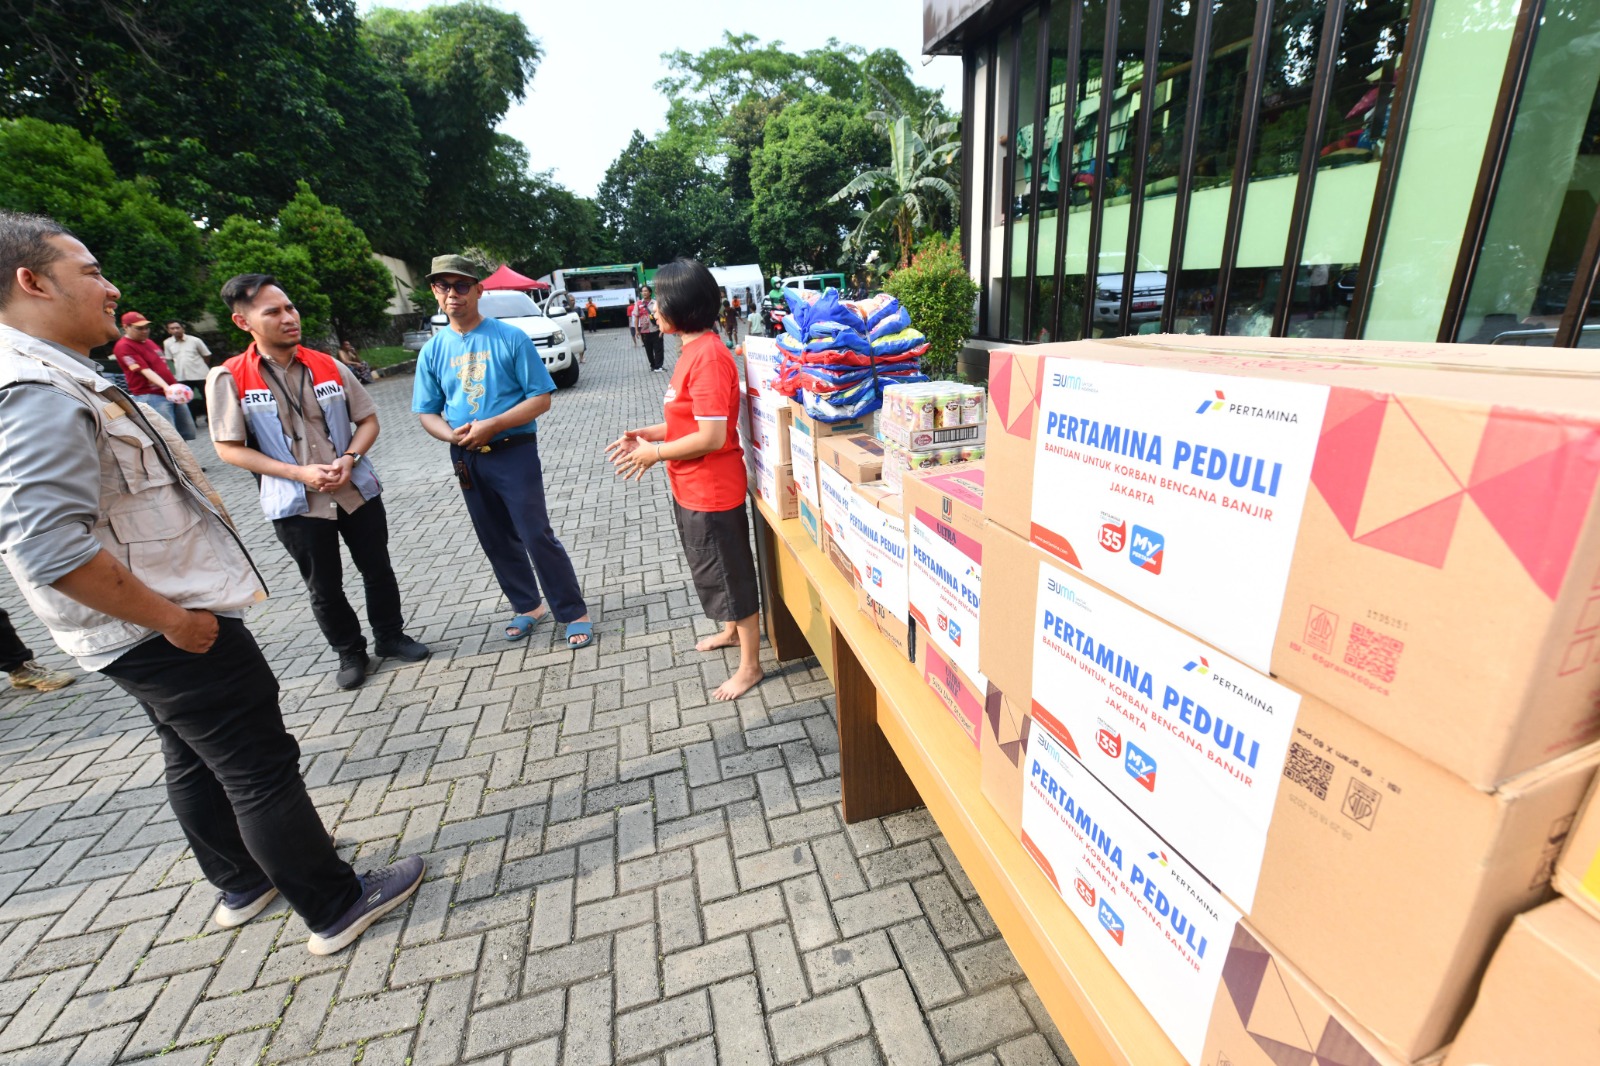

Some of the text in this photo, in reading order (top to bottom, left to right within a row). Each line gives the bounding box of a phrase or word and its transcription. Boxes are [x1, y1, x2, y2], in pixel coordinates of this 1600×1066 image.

[1229, 404, 1298, 424] PERTAMINA
[1046, 411, 1282, 497] PERTAMINA PEDULI
[1045, 443, 1273, 522] BANTUAN UNTUK KORBAN BENCANA BANJIR
[1110, 482, 1155, 505] JAKARTA
[850, 513, 879, 544] PERTAMINA
[880, 535, 905, 560] PEDULI
[936, 522, 956, 544] ULTRA
[1098, 526, 1122, 550] 135
[914, 544, 958, 592] PERTAMINA
[962, 584, 980, 608] PED
[1042, 635, 1077, 665] BANTUAN
[1079, 661, 1106, 686] UNTUK
[1109, 682, 1149, 715] KORBAN
[1151, 712, 1203, 754] BENCANA
[1207, 750, 1253, 788] BANJIR
[1044, 609, 1260, 769] PERTAMINA PEDULI
[1213, 674, 1274, 715] PERTAMINA
[1105, 696, 1147, 732] JAKARTA
[1030, 780, 1059, 816] BANTUAN
[1061, 811, 1083, 844] UNTUK
[1085, 843, 1118, 882] KORBAN
[1120, 881, 1162, 930] BENCANA
[1165, 931, 1200, 974] BANJIR
[1032, 759, 1208, 960] PERTAMINA PEDULI
[1082, 854, 1117, 895] JAKARTA
[1171, 869, 1219, 921] PERTAMINA
